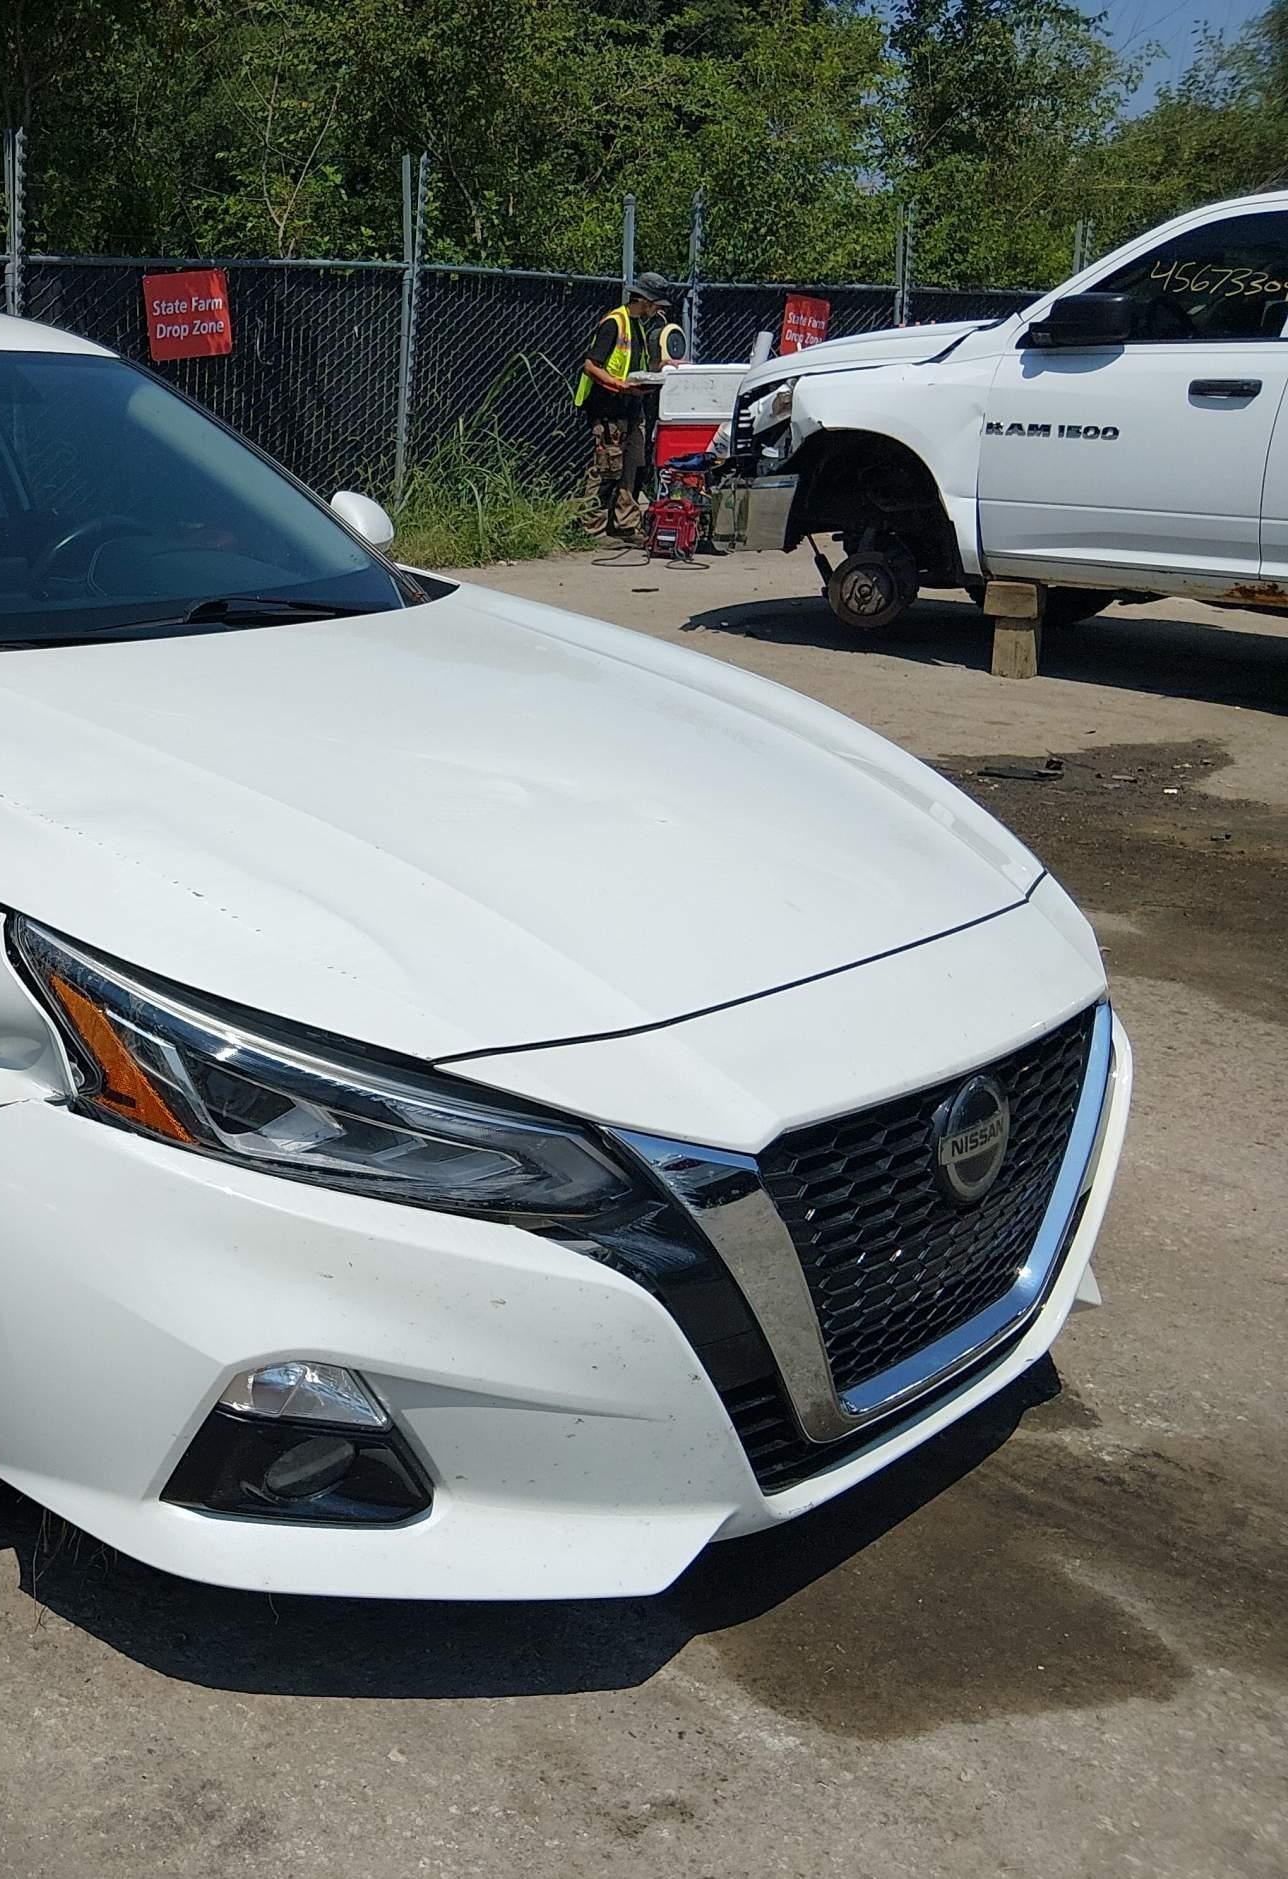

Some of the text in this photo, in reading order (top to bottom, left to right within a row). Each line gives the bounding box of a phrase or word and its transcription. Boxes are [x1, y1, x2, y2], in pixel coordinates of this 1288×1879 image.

[152, 297, 223, 316] State Farm
[156, 319, 225, 340] Drop Zone
[787, 311, 825, 329] State Farm
[785, 328, 804, 343] Drop
[985, 421, 1120, 440] RAM 1500
[952, 1119, 1004, 1157] NISSAN
